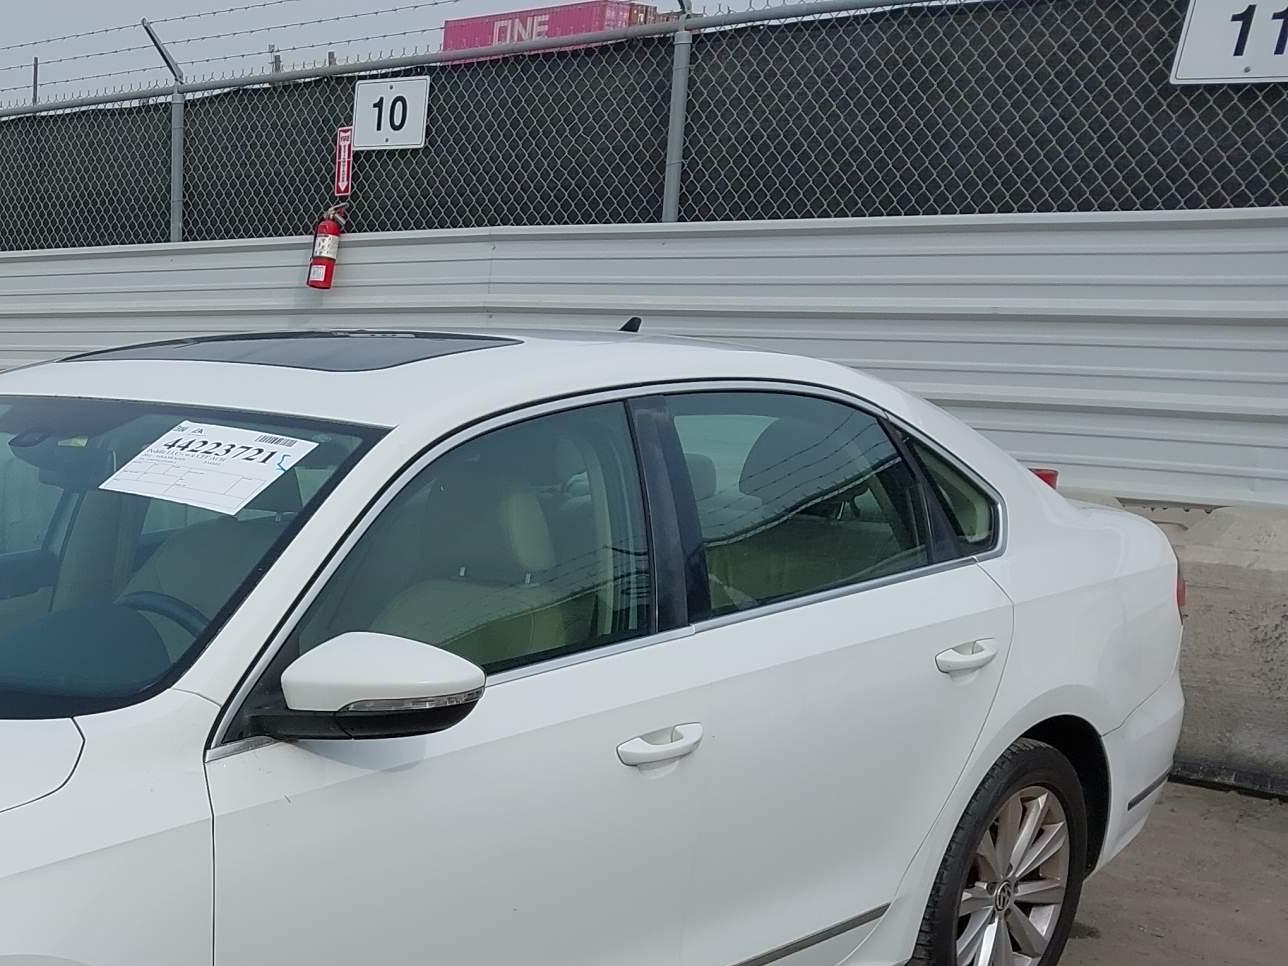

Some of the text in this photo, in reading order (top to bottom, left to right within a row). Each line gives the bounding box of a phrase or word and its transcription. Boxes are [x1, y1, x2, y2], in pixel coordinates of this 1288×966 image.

[492, 14, 550, 46] ONE
[1230, 3, 1288, 57] 11
[372, 95, 408, 132] 10
[163, 437, 278, 464] 44223721
